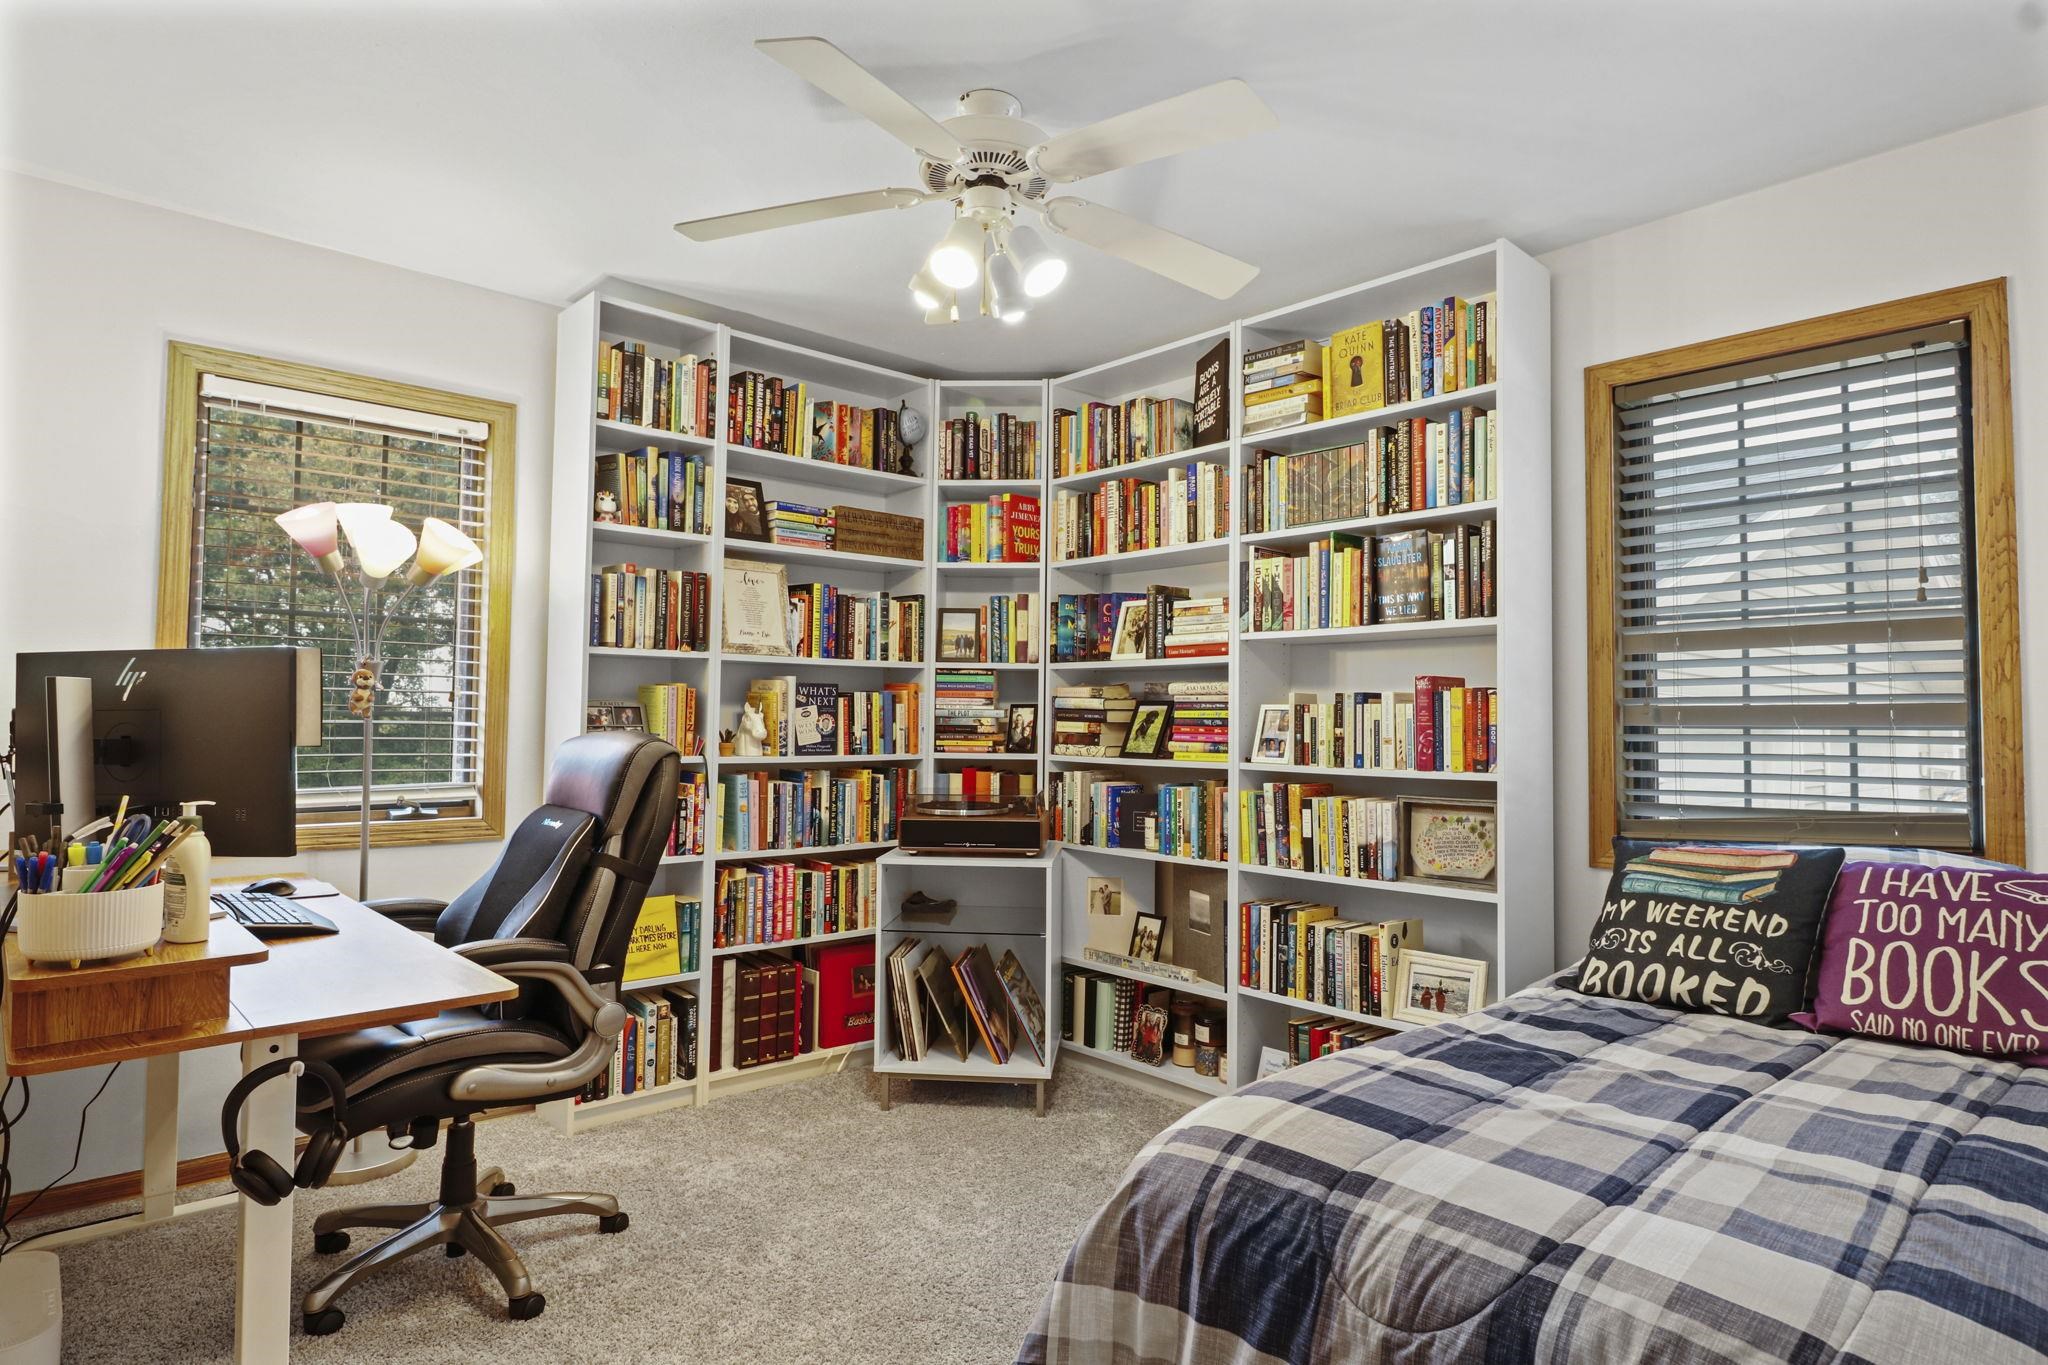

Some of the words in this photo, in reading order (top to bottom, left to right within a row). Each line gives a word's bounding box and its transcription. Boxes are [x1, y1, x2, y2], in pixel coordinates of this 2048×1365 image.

[1344, 330, 1366, 344] KATE
[1434, 308, 1443, 358] ATMOSPHERE
[1339, 340, 1374, 359] QUINN
[1199, 360, 1220, 385] BOOKS
[746, 381, 754, 406] HARLAN
[756, 383, 764, 407] HARLAN
[1198, 380, 1210, 398] ARE
[1212, 375, 1217, 388] A
[1195, 384, 1222, 412] UNIQUELY
[1335, 400, 1358, 412] BRIAR
[1360, 393, 1382, 408] CLUB
[746, 406, 754, 426] COBEN
[756, 408, 764, 427] COBEN
[1194, 396, 1221, 425] PORTABLE
[1198, 413, 1216, 434] MAGIC
[674, 456, 682, 472] FREDRIK
[674, 473, 682, 493] BACKMAN
[1018, 502, 1035, 512] ABBY
[674, 508, 682, 527] WINNERS
[1012, 524, 1040, 538] YOURS
[1486, 527, 1491, 535] WE
[1014, 541, 1040, 558] TRULY
[1378, 552, 1422, 567] SLAUGHTER
[1378, 595, 1395, 605] THIS
[1396, 593, 1404, 603] IS
[1406, 592, 1425, 602] WHY
[1385, 606, 1397, 616] WE
[1399, 604, 1418, 615] LIED
[115, 657, 147, 702] hp
[799, 686, 837, 696] WHAT'S
[809, 697, 834, 706] NEXT
[688, 724, 693, 732] Z
[1858, 866, 1872, 894] I
[1880, 868, 1994, 902] HAVE
[1600, 898, 1636, 923] MY
[1646, 899, 1789, 938] WEEKEND
[1853, 899, 1922, 936] TOO
[1938, 906, 2048, 952] MANY
[640, 924, 666, 934] DARLING
[640, 934, 657, 943] TIMES
[657, 931, 677, 942] BEFORE
[636, 944, 652, 952] HERE
[1624, 928, 1656, 954] IS
[1666, 933, 1727, 964] ALL
[1578, 956, 1771, 1016] BOOKED
[1840, 937, 2048, 1032] BOOKS
[1850, 1010, 1895, 1036] SAID
[1902, 1016, 1927, 1042] NO
[1934, 1023, 1974, 1050] ONE
[1982, 1030, 2040, 1055] EVER
